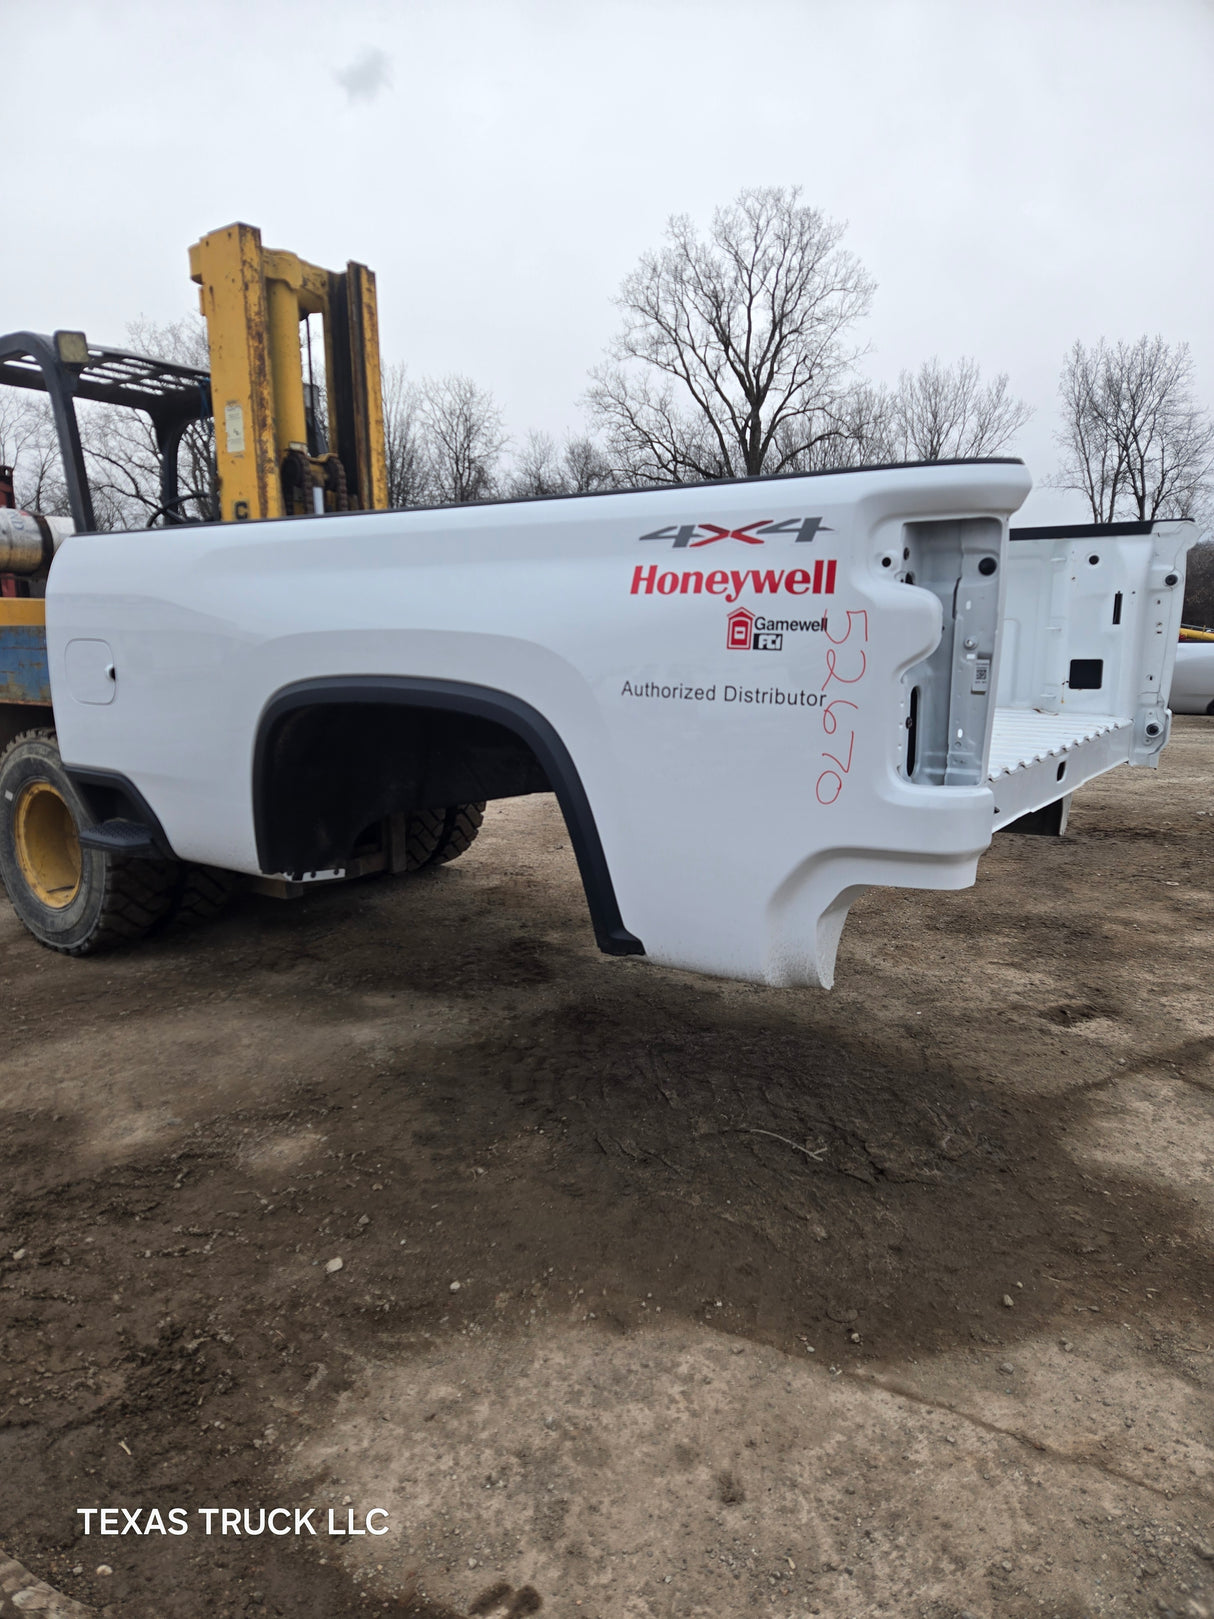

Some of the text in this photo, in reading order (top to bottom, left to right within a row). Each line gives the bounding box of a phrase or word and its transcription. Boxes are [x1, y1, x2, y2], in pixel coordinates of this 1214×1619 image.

[629, 559, 838, 603] Honeywell
[754, 616, 828, 632] Gamewell
[621, 680, 827, 707] Authorized Distributor
[815, 608, 869, 806] 52670
